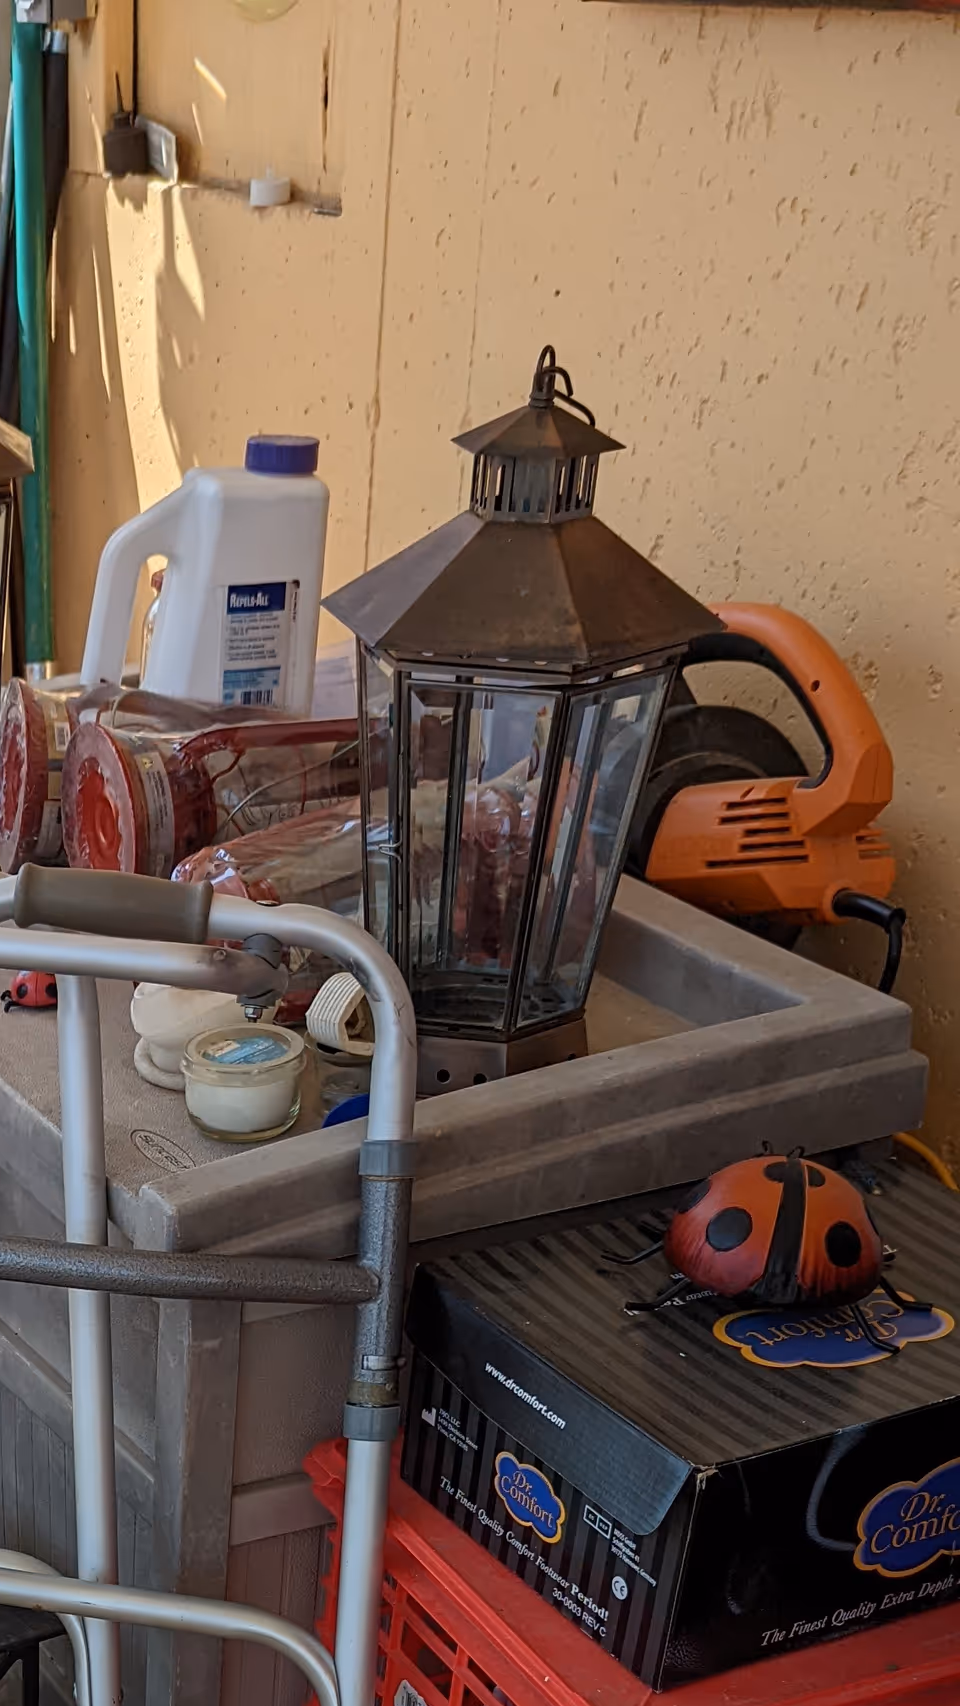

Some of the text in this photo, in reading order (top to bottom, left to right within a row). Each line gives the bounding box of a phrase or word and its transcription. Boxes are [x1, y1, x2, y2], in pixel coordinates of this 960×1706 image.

[485, 1362, 566, 1430] www.drcomfort.com
[501, 1475, 555, 1529] Comfort
[513, 1470, 533, 1496] Dr.
[900, 1491, 946, 1522] Dr.
[440, 1475, 609, 1622] The Finest Quality Comfort Footwear Period!
[552, 1587, 607, 1637] 30-0003 REV C
[761, 1629, 786, 1646] The
[788, 1615, 828, 1638] Finest
[831, 1600, 877, 1627] Quality
[879, 1590, 915, 1610] Extra
[917, 1574, 954, 1599] Depth
